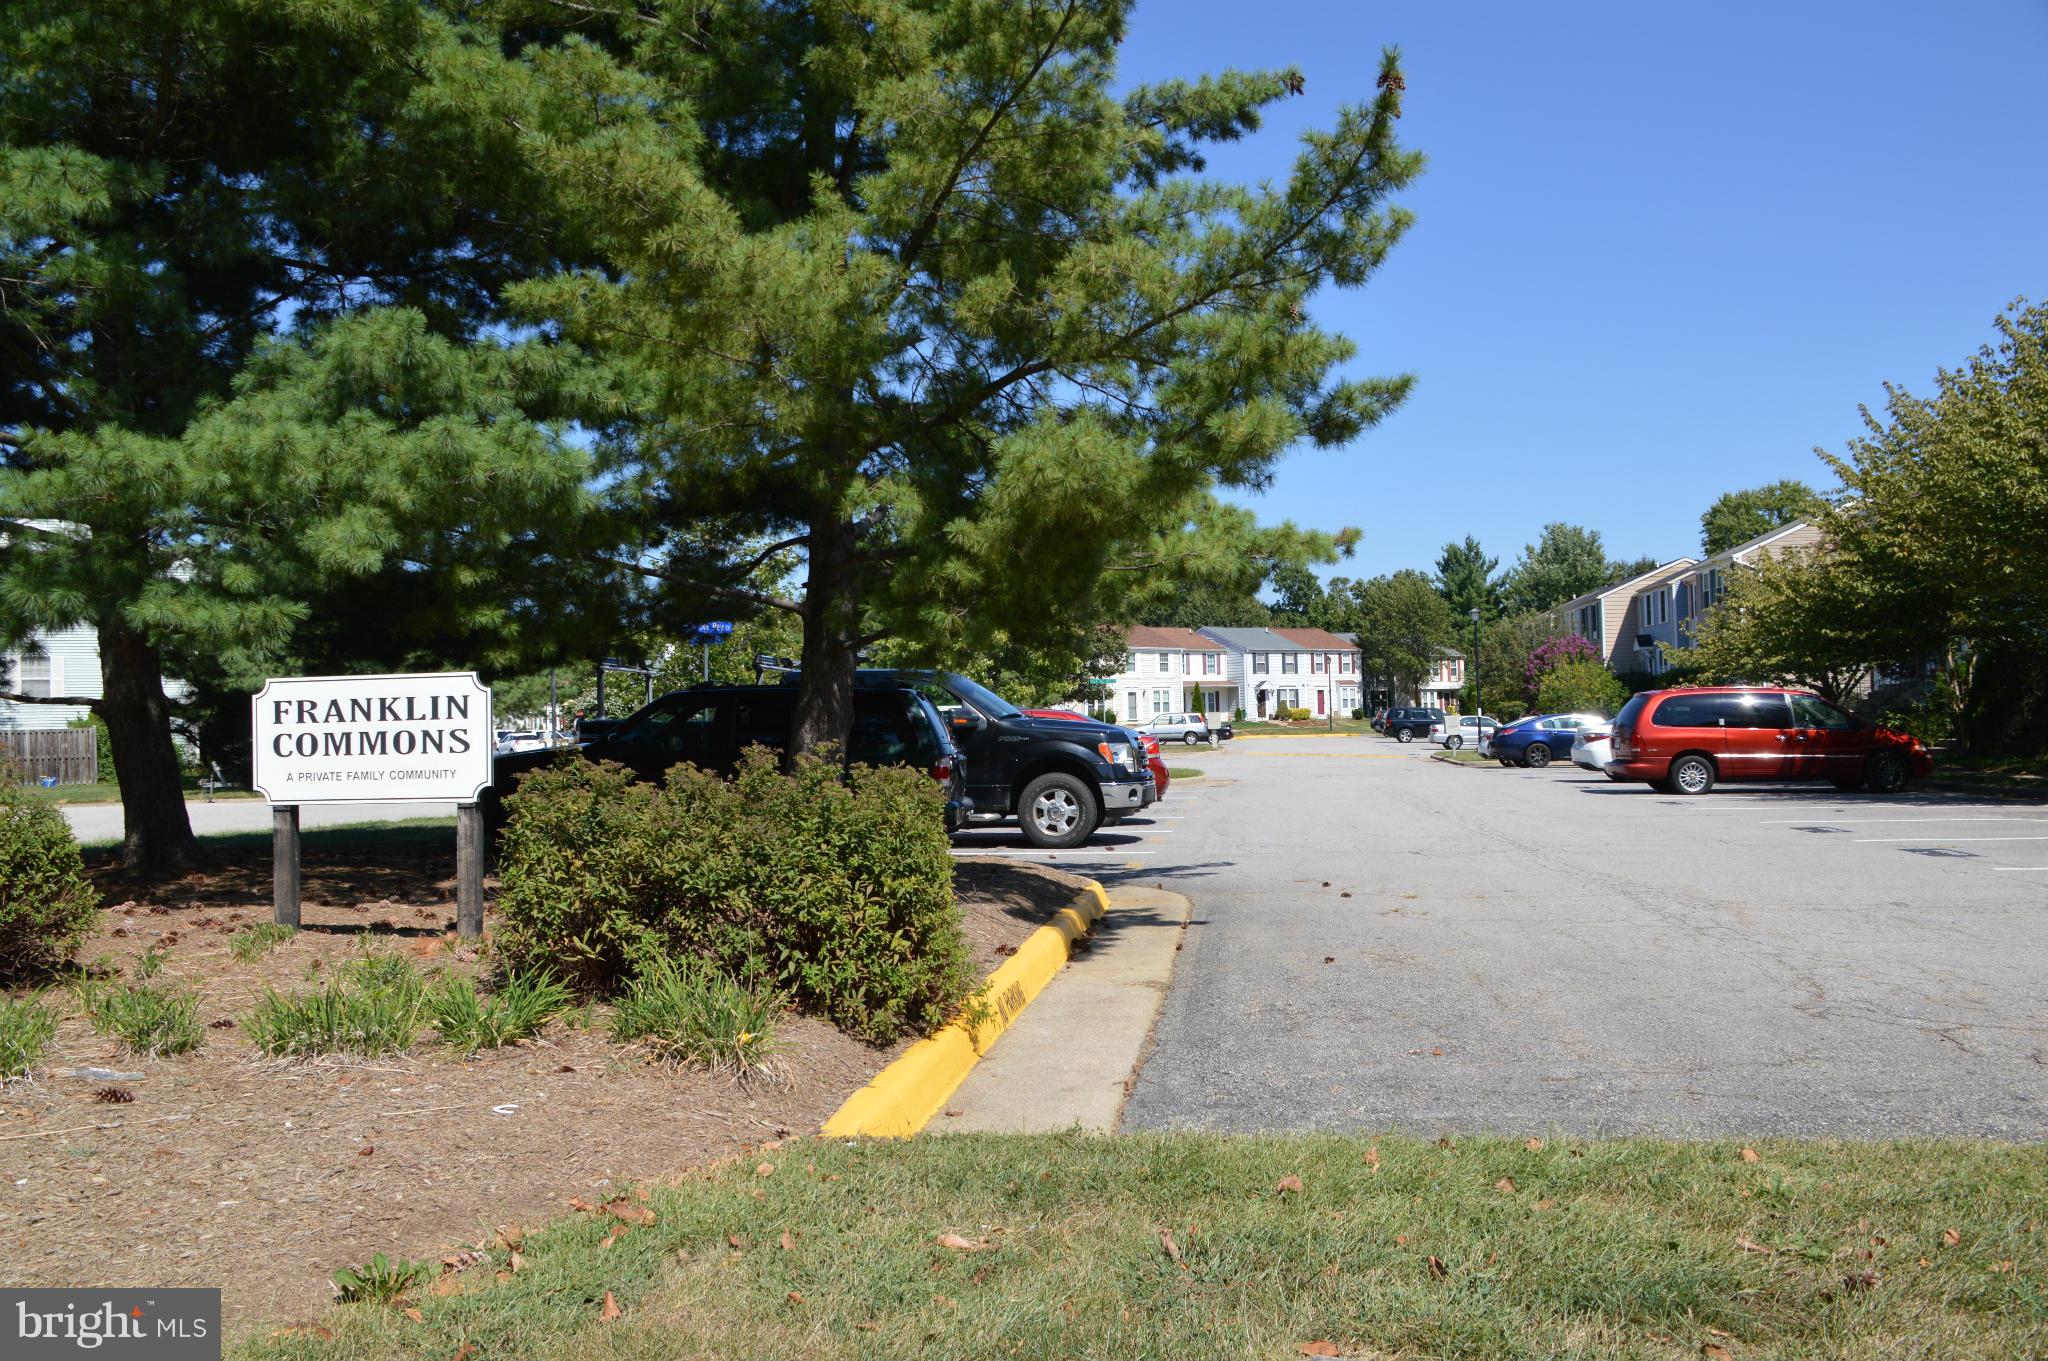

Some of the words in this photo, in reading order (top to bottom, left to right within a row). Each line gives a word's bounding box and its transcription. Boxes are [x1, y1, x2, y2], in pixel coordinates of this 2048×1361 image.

[272, 695, 470, 725] FRANKLIN
[272, 728, 471, 758] COMMONS
[286, 772, 294, 782] A
[298, 771, 342, 782] PRIVATE
[347, 770, 385, 781] FAMILY
[389, 769, 457, 780] COMMUNITY
